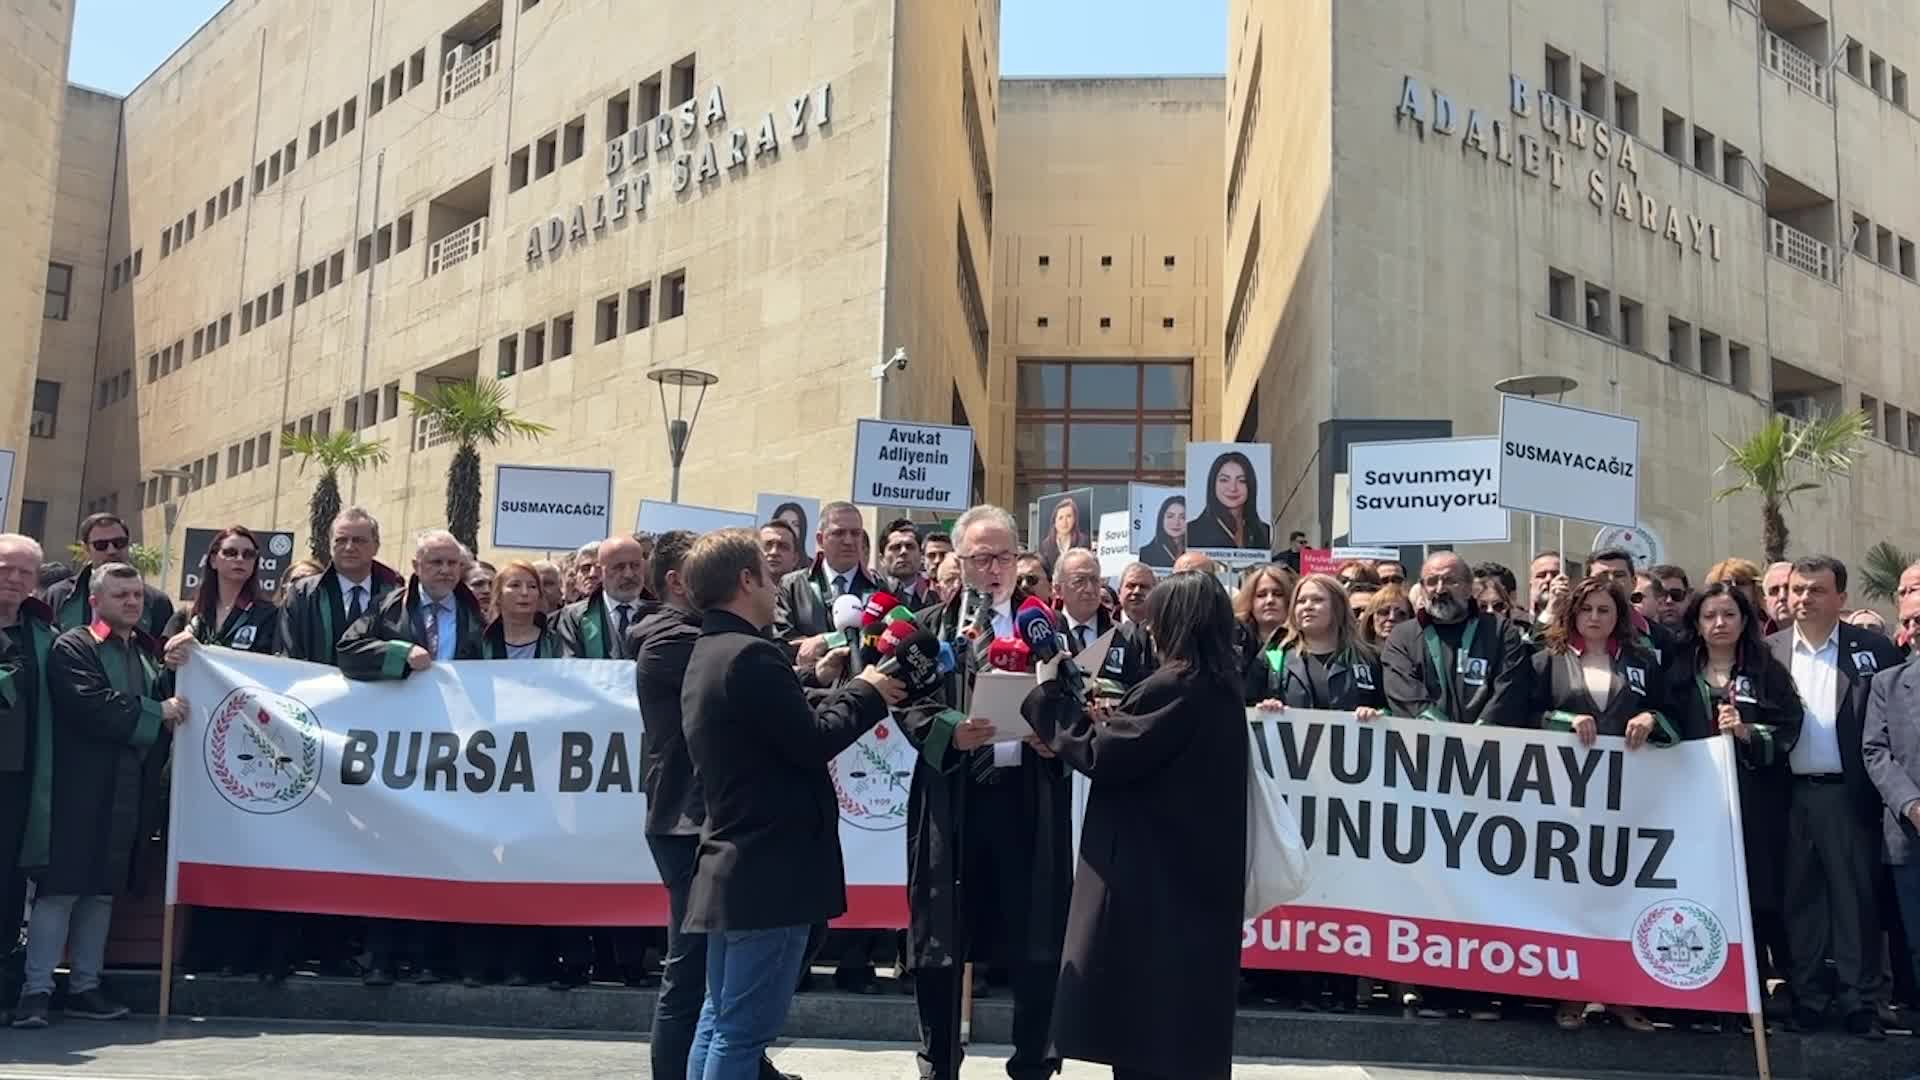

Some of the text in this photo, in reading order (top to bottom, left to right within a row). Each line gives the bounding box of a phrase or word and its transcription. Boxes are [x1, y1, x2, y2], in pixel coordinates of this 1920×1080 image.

[606, 84, 727, 177] BURSA
[1510, 73, 1638, 176] BURSA
[526, 82, 834, 263] ADALET SARAYI
[1397, 75, 1722, 262] ADALET SARAYI
[889, 427, 941, 446] Avukat
[877, 444, 949, 466] Adliyenin
[1504, 441, 1634, 477] SUSMAYACAĞIZ
[898, 464, 927, 482] Asli
[1364, 467, 1492, 488] Savunmayı
[871, 481, 952, 503] Unsurudur
[500, 498, 606, 518] SUSMAYACAĞIZ
[863, 634, 880, 647] NT
[1032, 622, 1052, 643] AA
[340, 729, 536, 793] BURSA
[1386, 919, 1580, 981] Barosu
